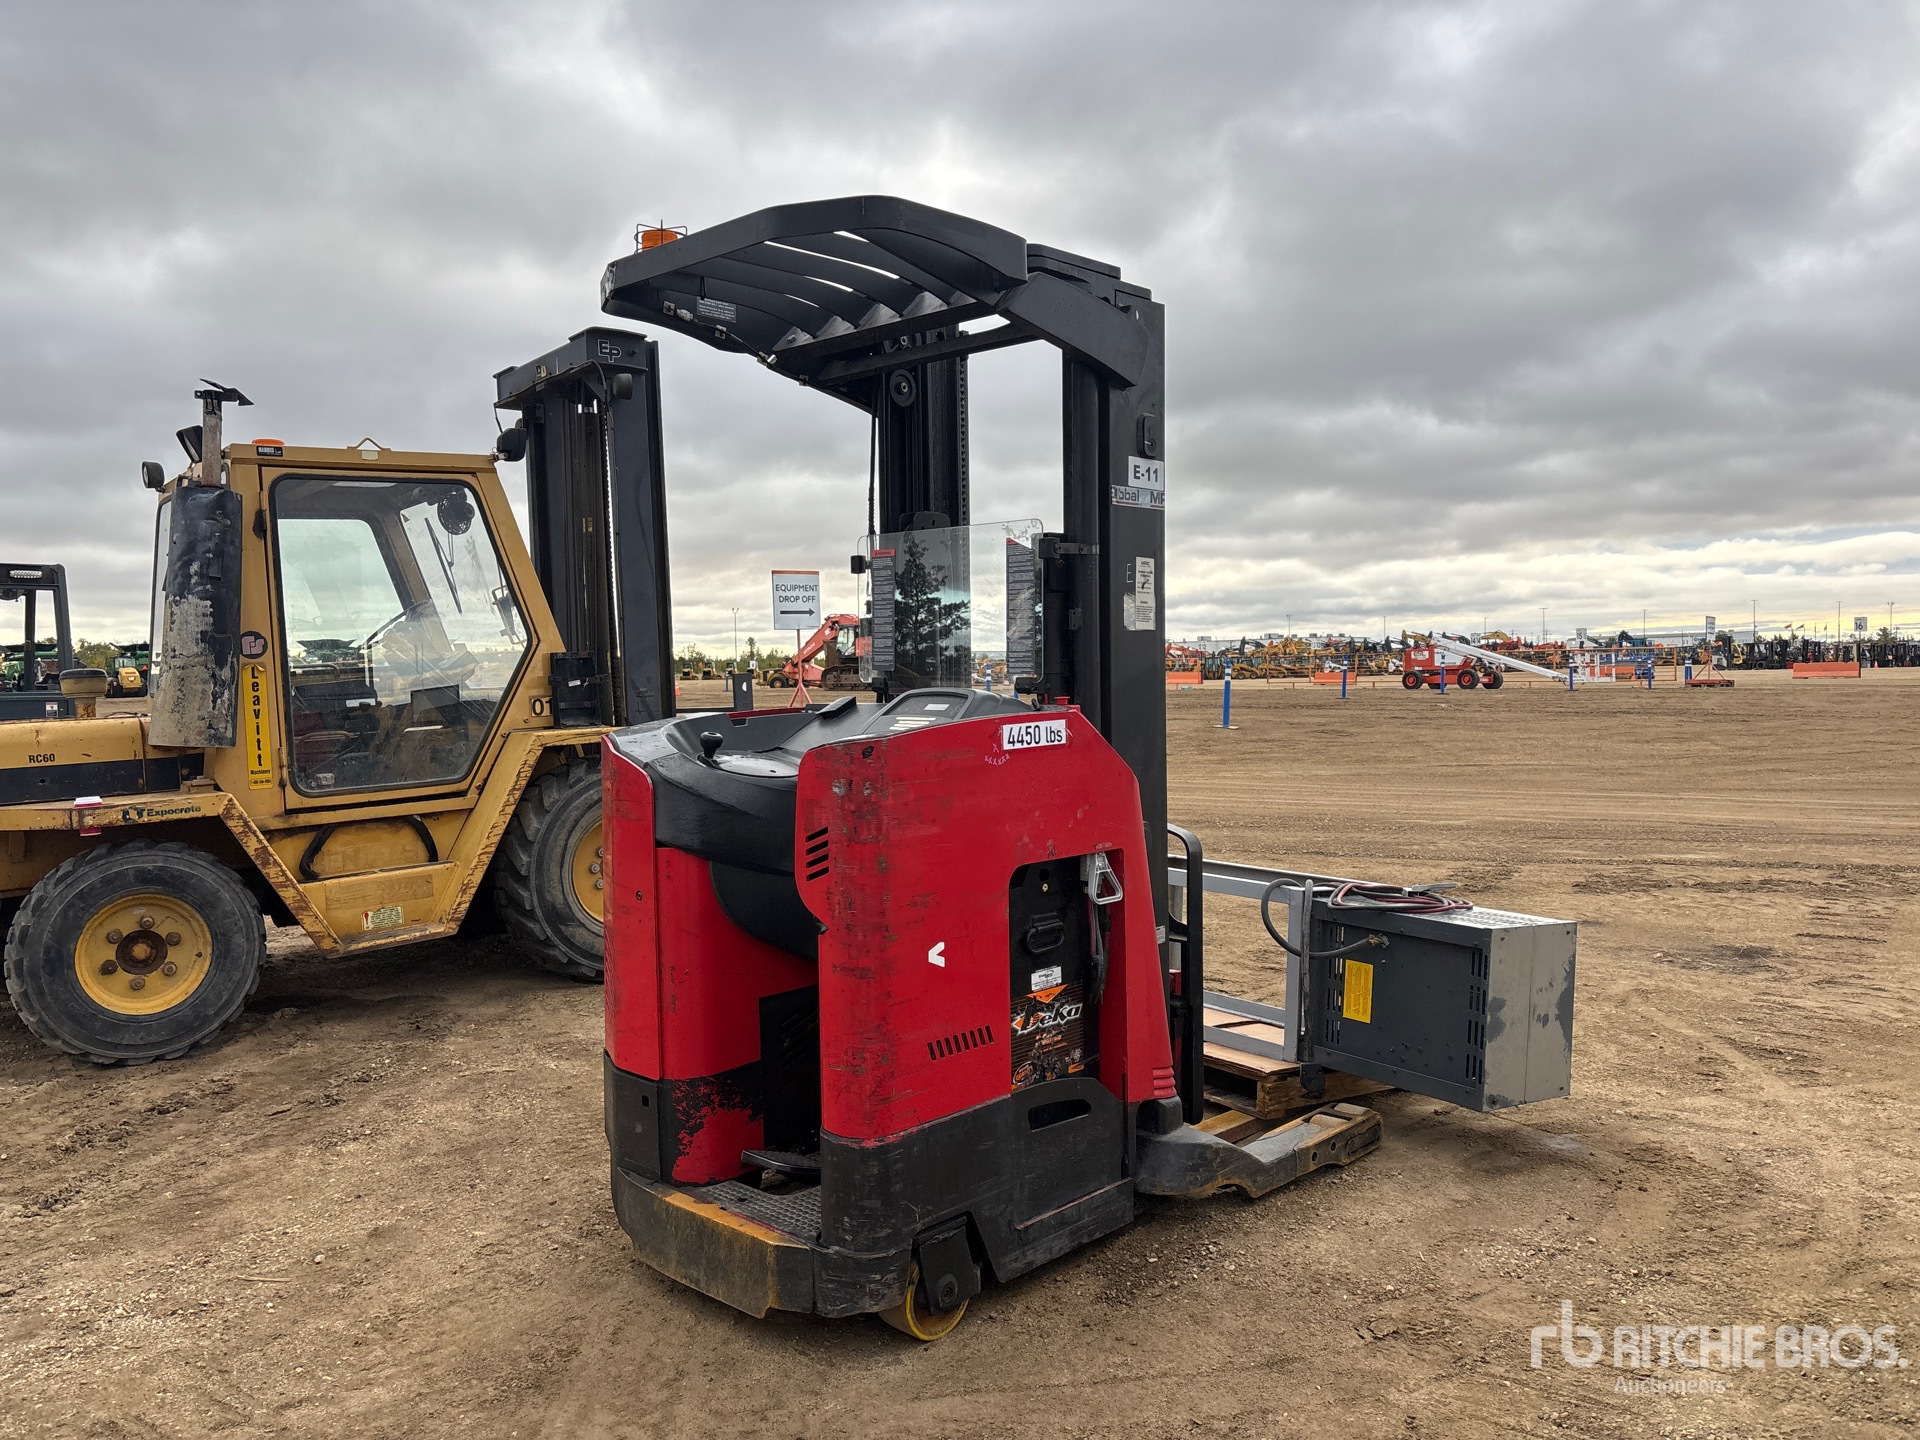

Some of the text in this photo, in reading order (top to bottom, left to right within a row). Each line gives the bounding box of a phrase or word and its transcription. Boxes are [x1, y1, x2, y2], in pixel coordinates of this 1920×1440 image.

[598, 339, 622, 363] EP
[1133, 464, 1158, 483] E-11
[775, 583, 818, 593] EQUIPMENT
[778, 595, 816, 603] DROP OFF
[1855, 621, 1864, 631] 16
[1007, 724, 1063, 747] 4450 lbs
[28, 753, 56, 764] RC60
[146, 804, 202, 818] Expocrete
